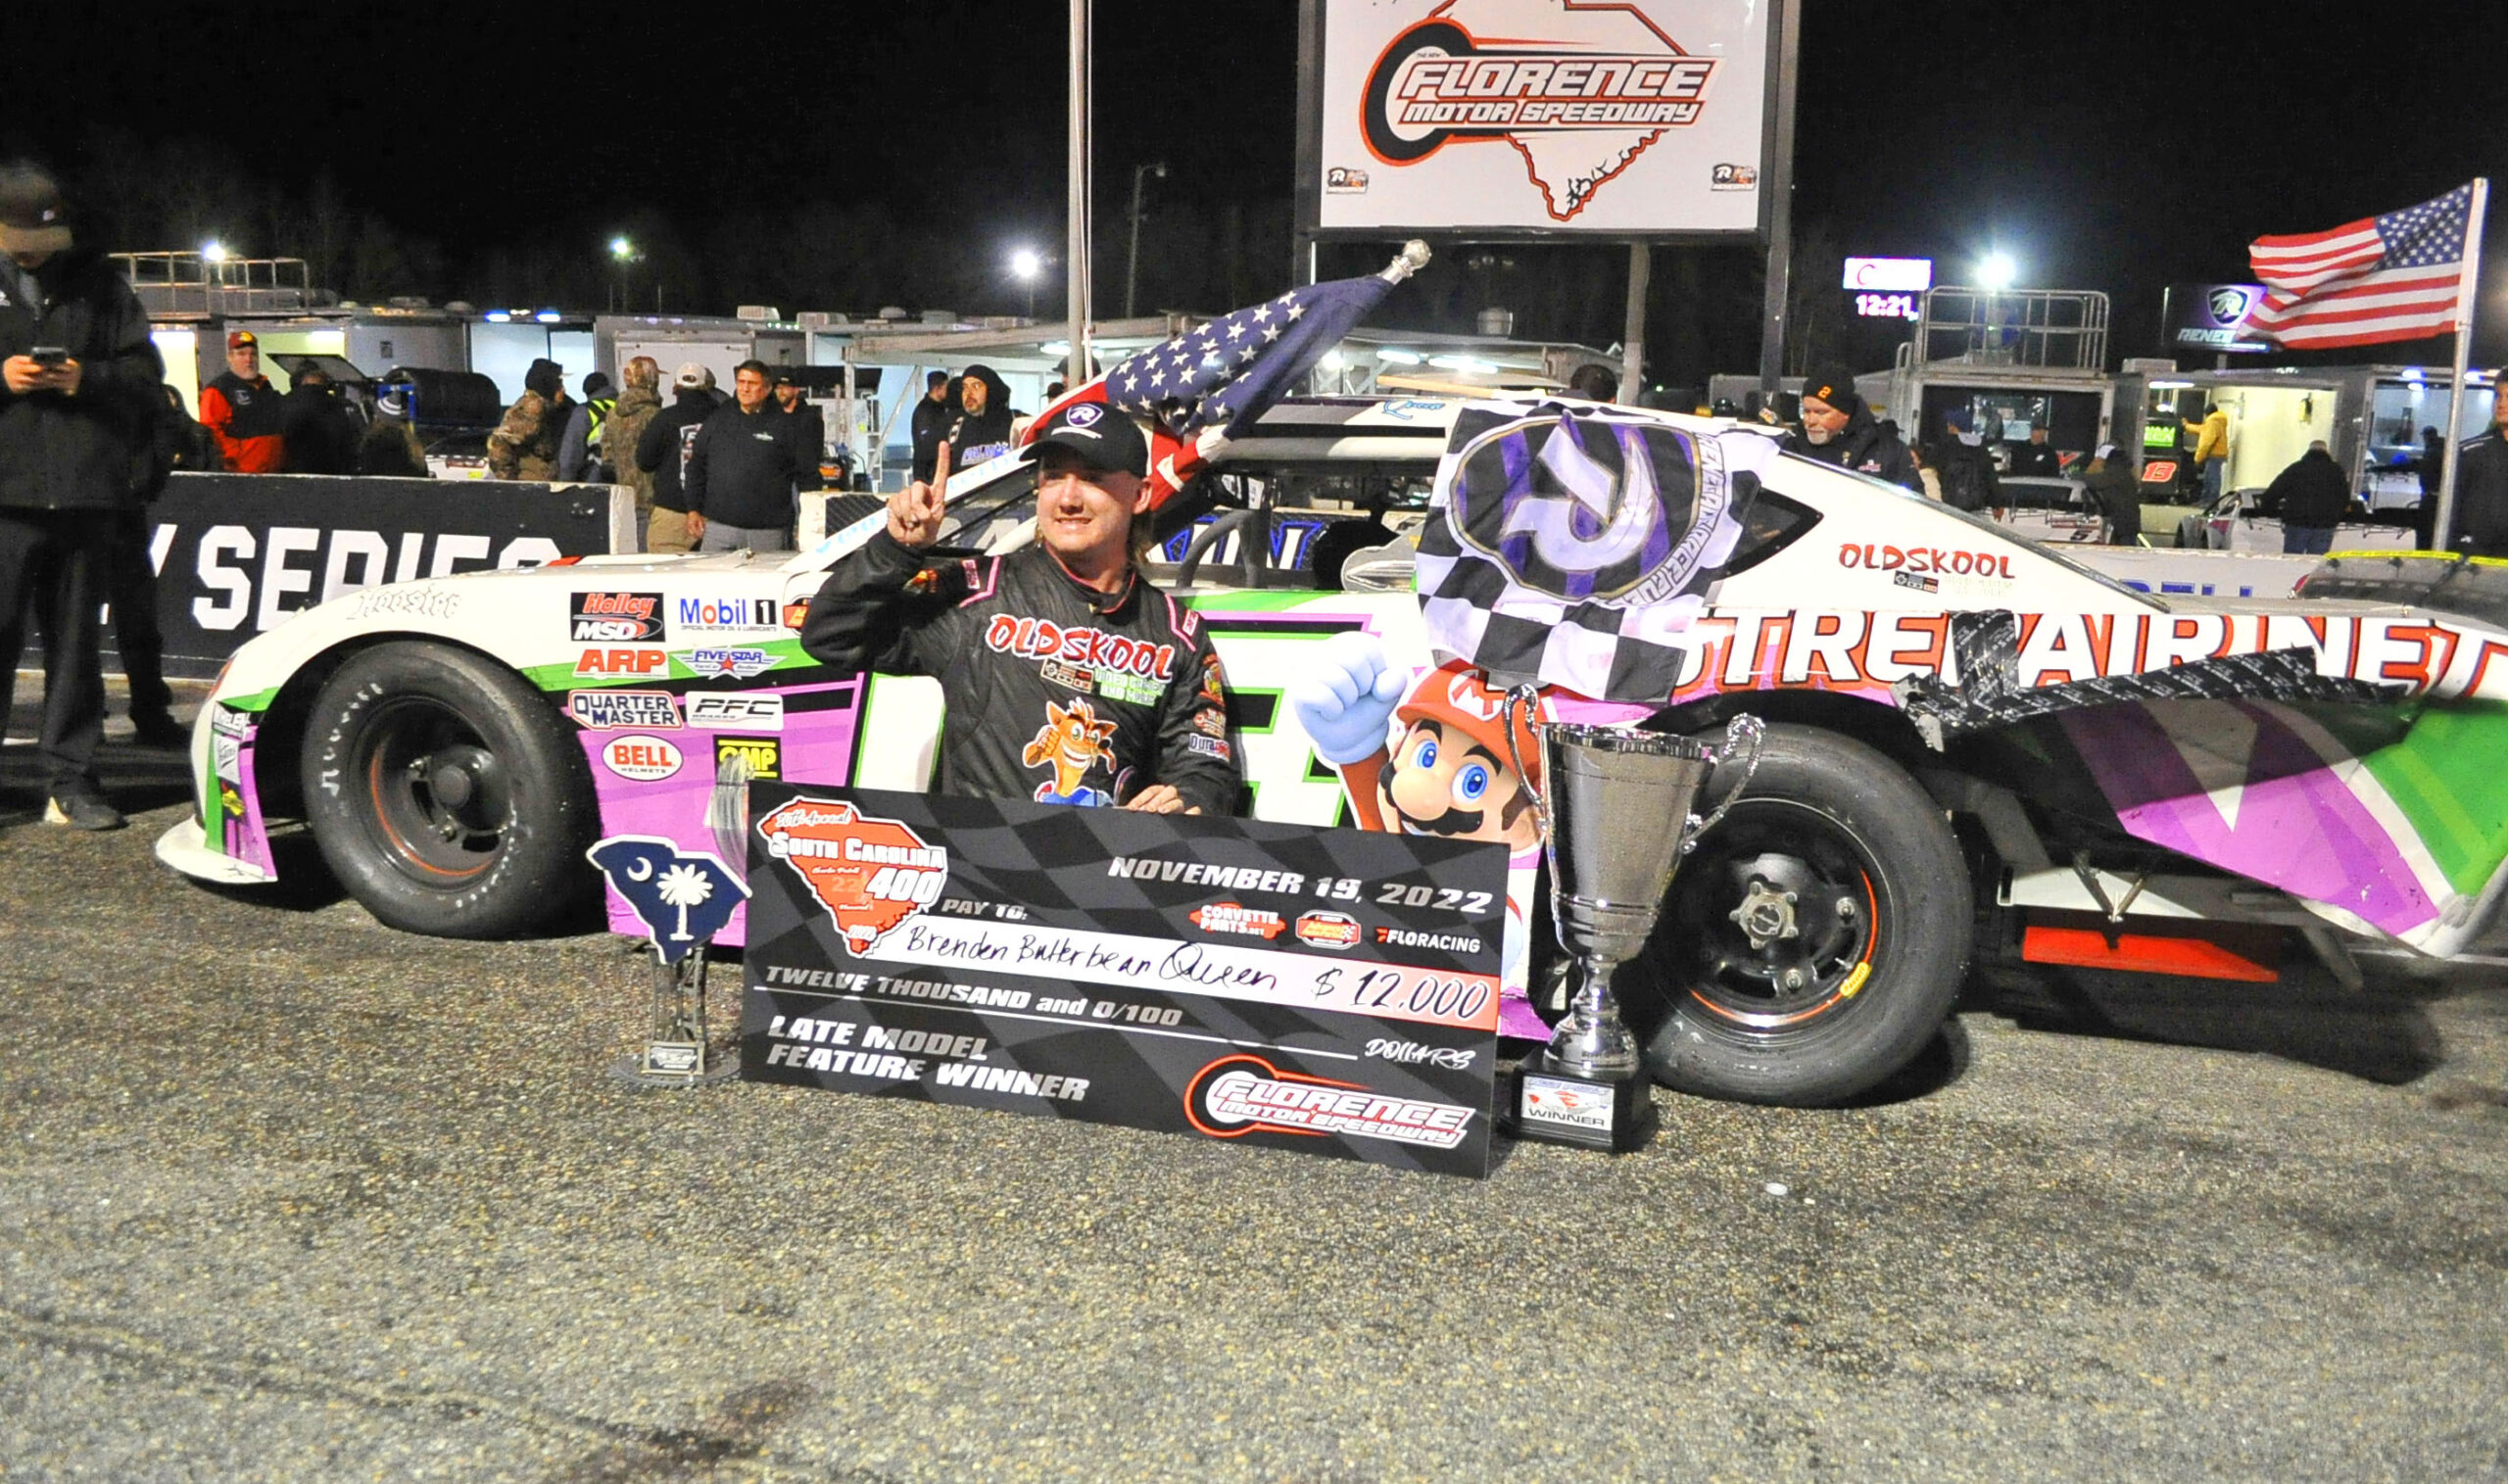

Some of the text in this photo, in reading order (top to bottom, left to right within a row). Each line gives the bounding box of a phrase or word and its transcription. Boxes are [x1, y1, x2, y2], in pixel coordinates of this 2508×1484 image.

[1400, 61, 1713, 98] FLORENCE
[1402, 101, 1700, 124] MOTOR SPEEDWAY
[1839, 544, 2015, 579] OLDSKOOL
[582, 594, 658, 619] Holley
[680, 598, 747, 624] Mobil
[574, 621, 637, 640] MSD
[695, 650, 762, 663] FIVE STAR
[987, 613, 1174, 681] OLDSKOOL
[577, 649, 666, 672] ARP
[574, 695, 669, 715] QUARTER
[593, 710, 676, 725] MASTER
[696, 698, 780, 716] PFC
[613, 744, 674, 767] BELL
[865, 867, 944, 904] 400
[1108, 857, 1494, 914] NOVEMBER 19, 2022
[942, 898, 1028, 921] PAY TO:
[1200, 904, 1278, 924] CORVETTE
[1386, 929, 1481, 953] FLORACING
[907, 926, 1009, 961] Brenden
[1159, 941, 1278, 990] Queen
[767, 966, 1183, 1026] TWELVE THOUSAND and 0/100
[768, 1015, 989, 1061] LATE MODEL
[767, 1044, 1090, 1101] FEATURE WINNER
[1213, 1078, 1470, 1129] FLORENCE
[1218, 1099, 1461, 1142] MOTOR SPEEDWAY
[1528, 1108, 1605, 1126] WINNER
